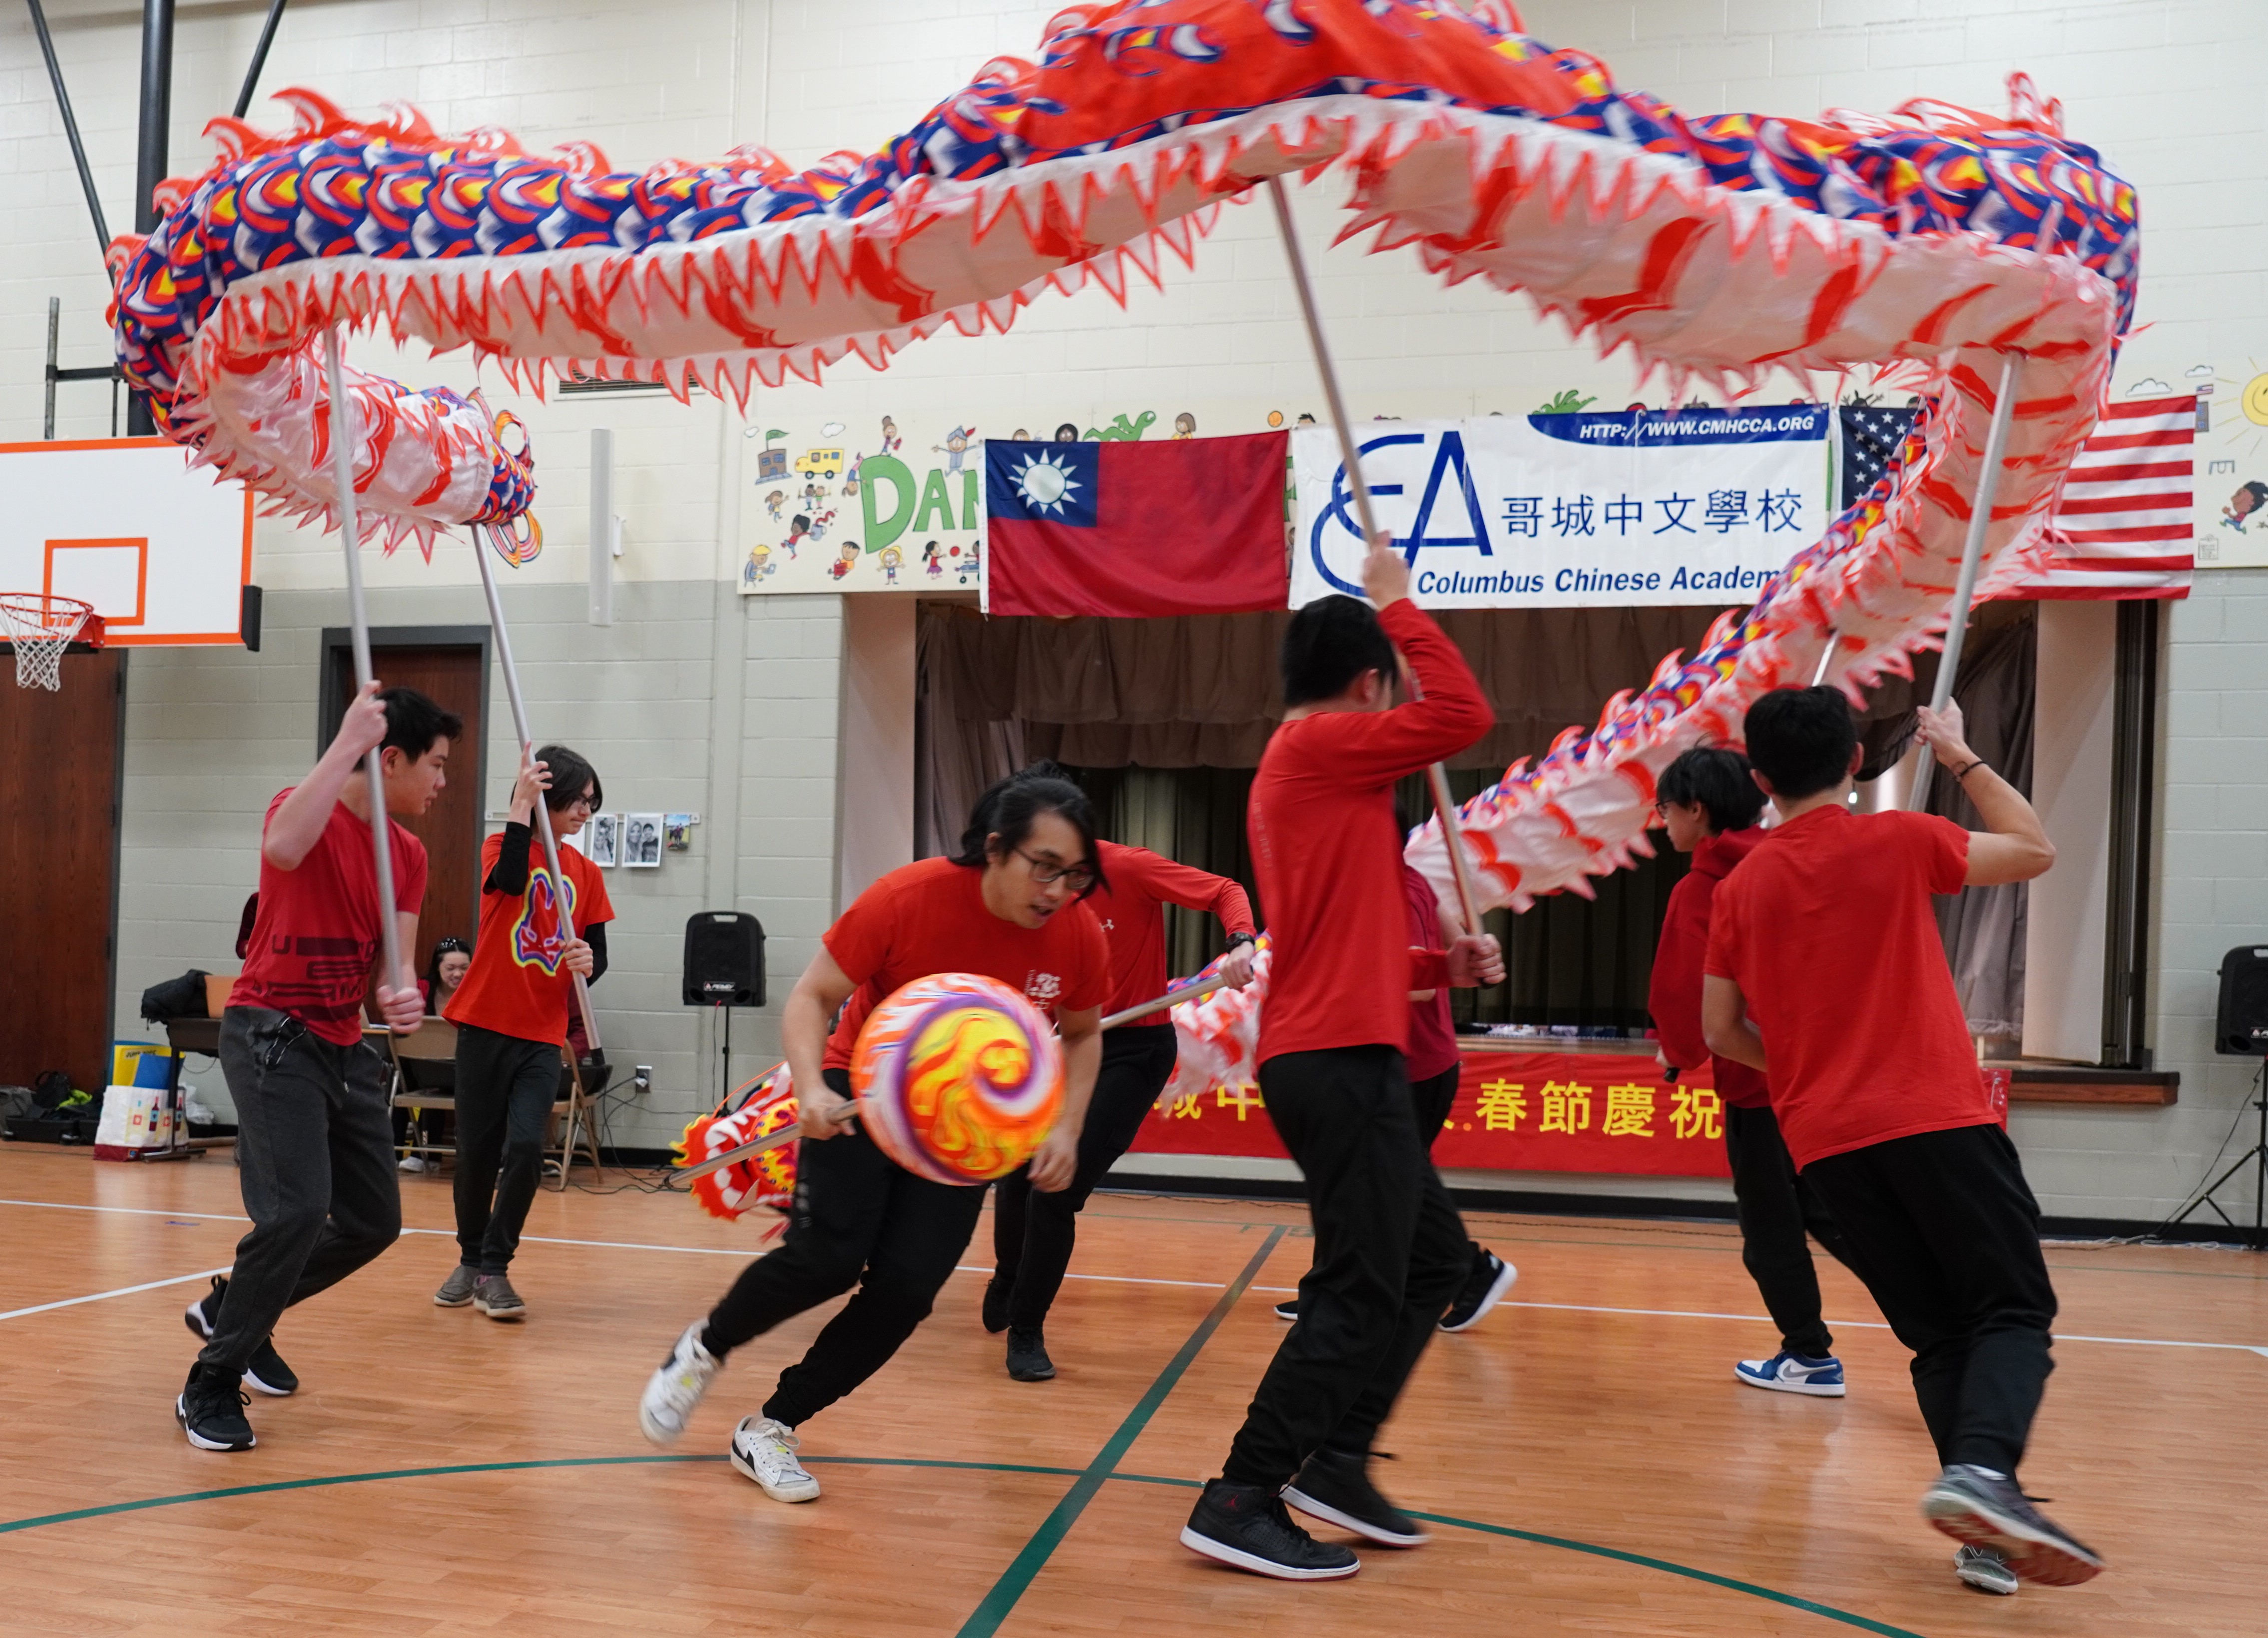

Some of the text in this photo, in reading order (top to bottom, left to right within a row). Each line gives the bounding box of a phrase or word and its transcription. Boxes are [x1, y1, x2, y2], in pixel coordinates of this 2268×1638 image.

[1580, 416, 1814, 439] HTTP://WWW.CMHCCA.ORG
[1502, 489, 1802, 538] 哥城中文學校
[1418, 571, 1544, 594] Columbus
[1555, 568, 1661, 592] Chinese
[1476, 1078, 1723, 1139] 春節慶祝
